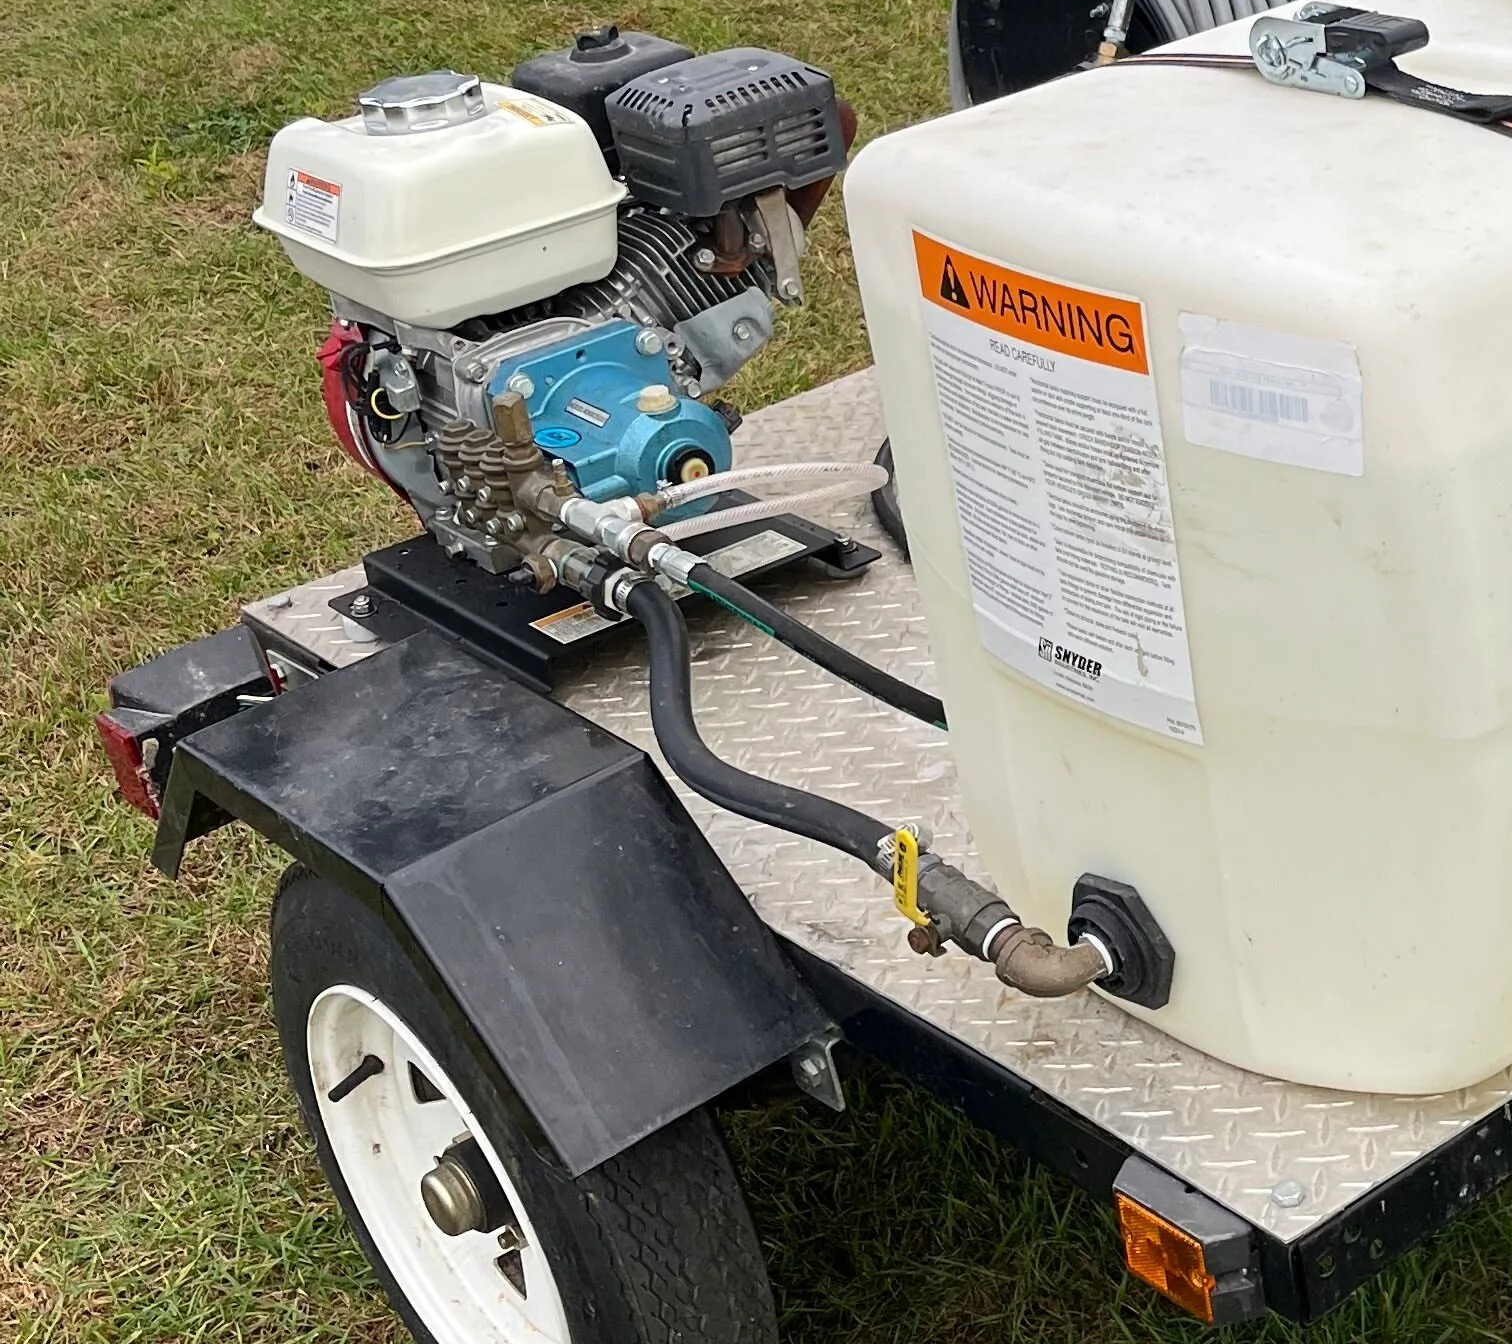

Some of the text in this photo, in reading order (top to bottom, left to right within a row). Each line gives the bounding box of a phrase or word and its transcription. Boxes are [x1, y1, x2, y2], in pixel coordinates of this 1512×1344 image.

[969, 271, 1135, 355] WARNING
[989, 338, 1010, 357] READ
[1054, 645, 1103, 677] SNYDER
